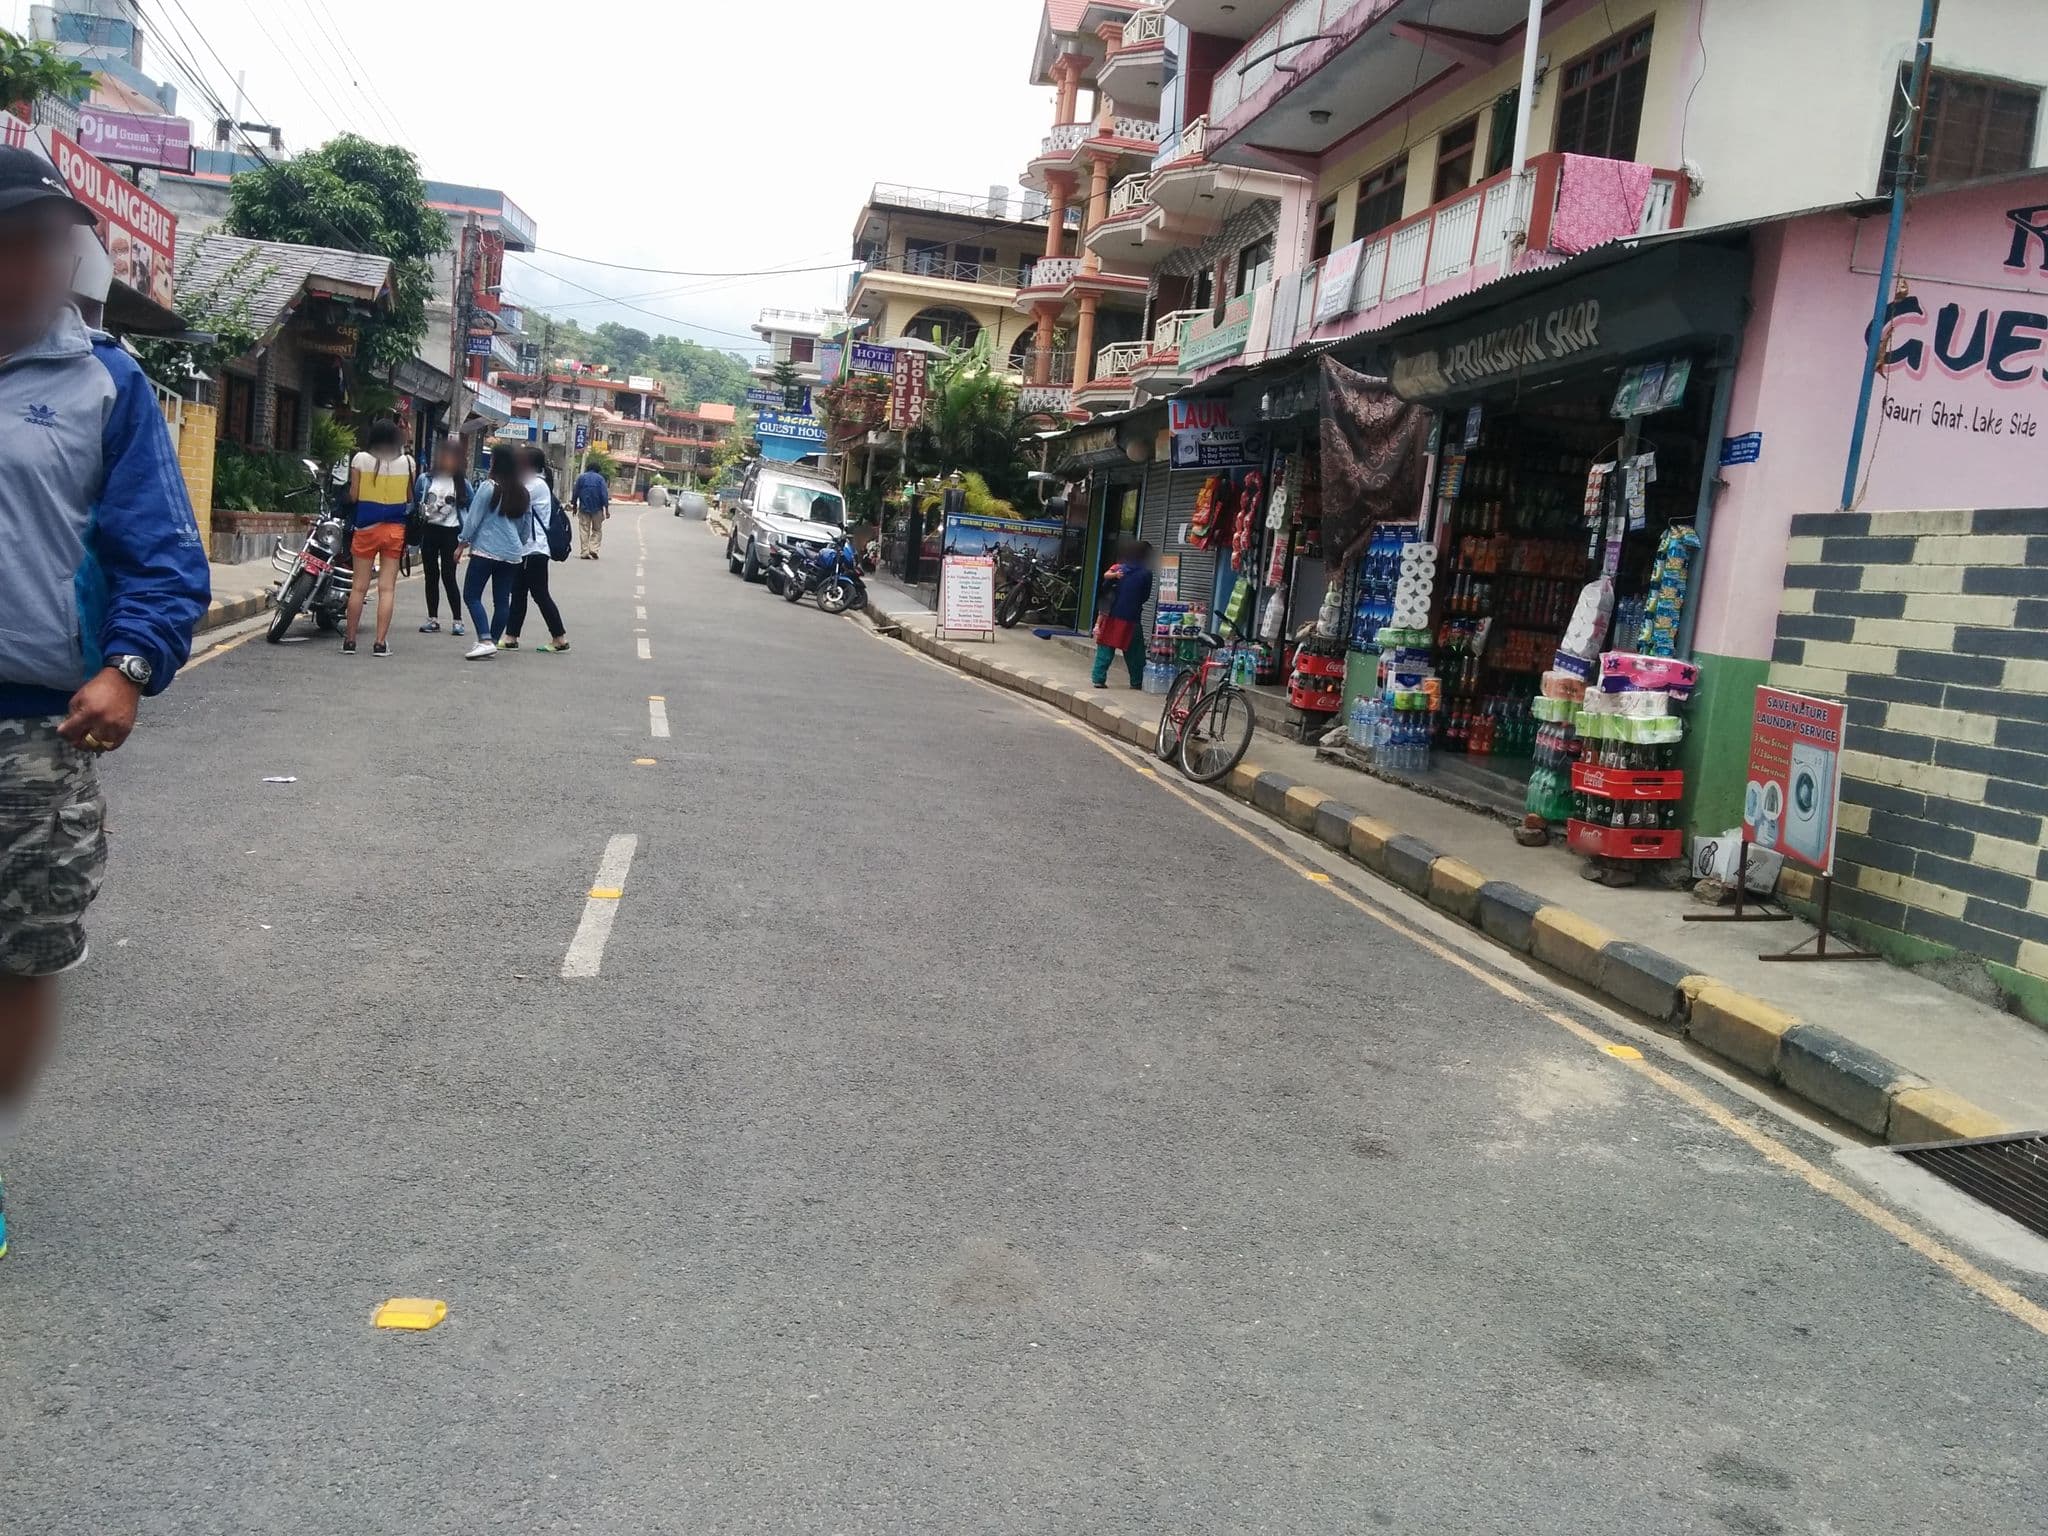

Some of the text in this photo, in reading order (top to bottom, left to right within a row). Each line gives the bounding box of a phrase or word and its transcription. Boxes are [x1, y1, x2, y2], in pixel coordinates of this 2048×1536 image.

[80, 115, 118, 143] Oju
[119, 129, 149, 143] Guest
[59, 142, 170, 249] BOULANGERIE
[1545, 299, 1599, 358] SHOP
[1864, 296, 2048, 382] GUE
[894, 362, 908, 420] HOTEL
[908, 359, 924, 422] HOLIDAY
[760, 422, 796, 435] GUEST
[778, 415, 820, 427] PACIFIC
[1884, 397, 1922, 425] Gauri
[1972, 406, 2002, 435] Lake
[2010, 412, 2037, 437] Side
[1757, 712, 1837, 742] LAUNDRY SERVICE
[1767, 696, 1828, 721] SAVE NATURE
